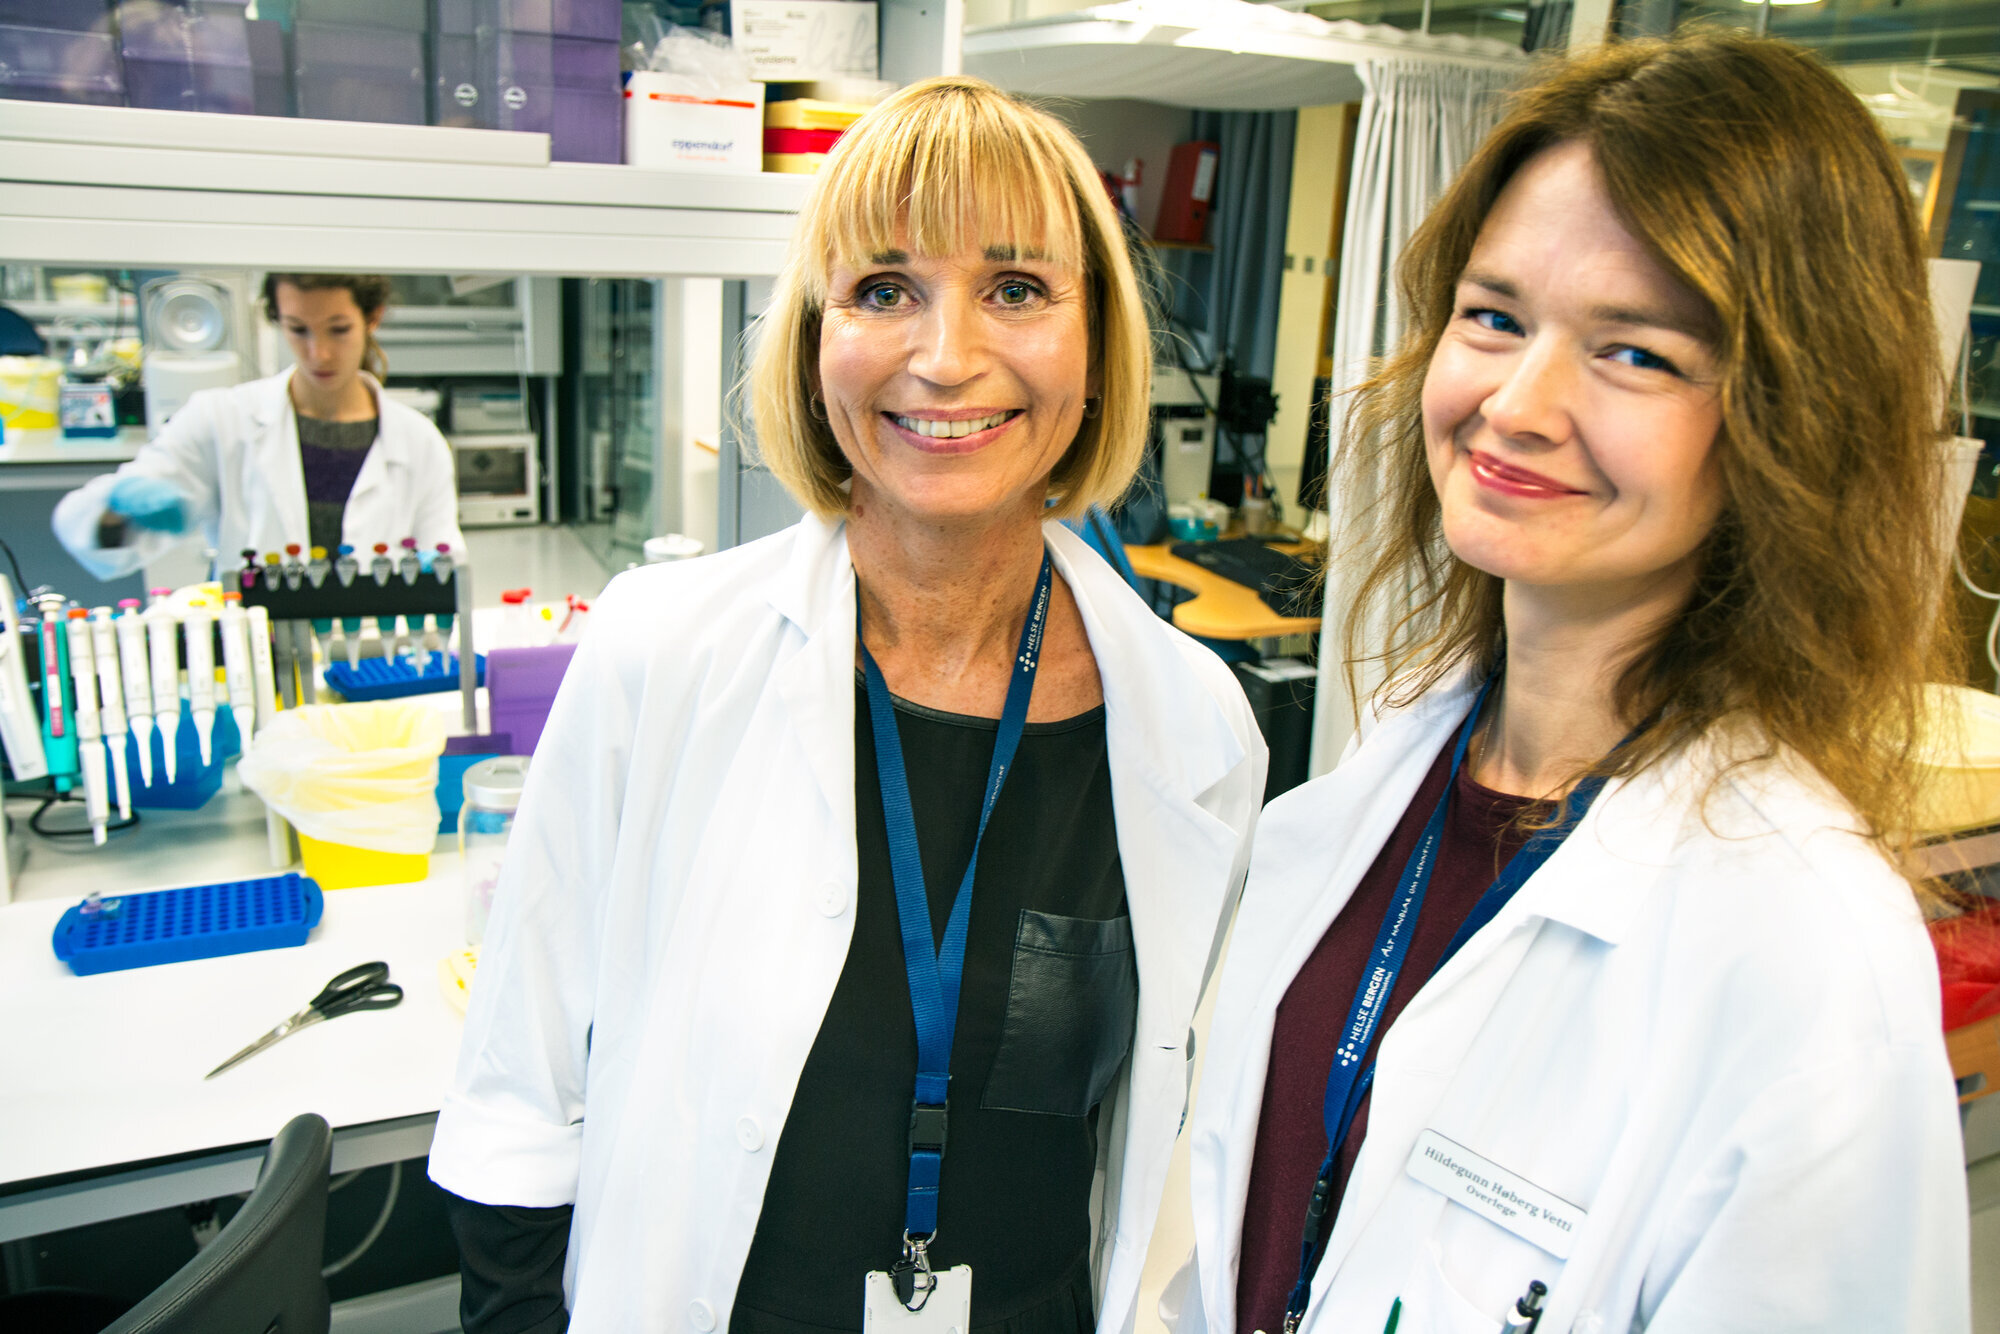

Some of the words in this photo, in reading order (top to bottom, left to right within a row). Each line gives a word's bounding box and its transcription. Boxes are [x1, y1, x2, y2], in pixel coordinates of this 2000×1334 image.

[1027, 621, 1039, 650] HELSE
[1034, 584, 1048, 622] BERGEN
[1349, 1007, 1370, 1041] HELSE
[1362, 966, 1387, 1009] BERGEN
[1425, 1146, 1489, 1188] Hildegunn
[1491, 1182, 1540, 1217] Høberg
[1542, 1208, 1574, 1233] Vetti
[1466, 1185, 1518, 1217] Overlege
